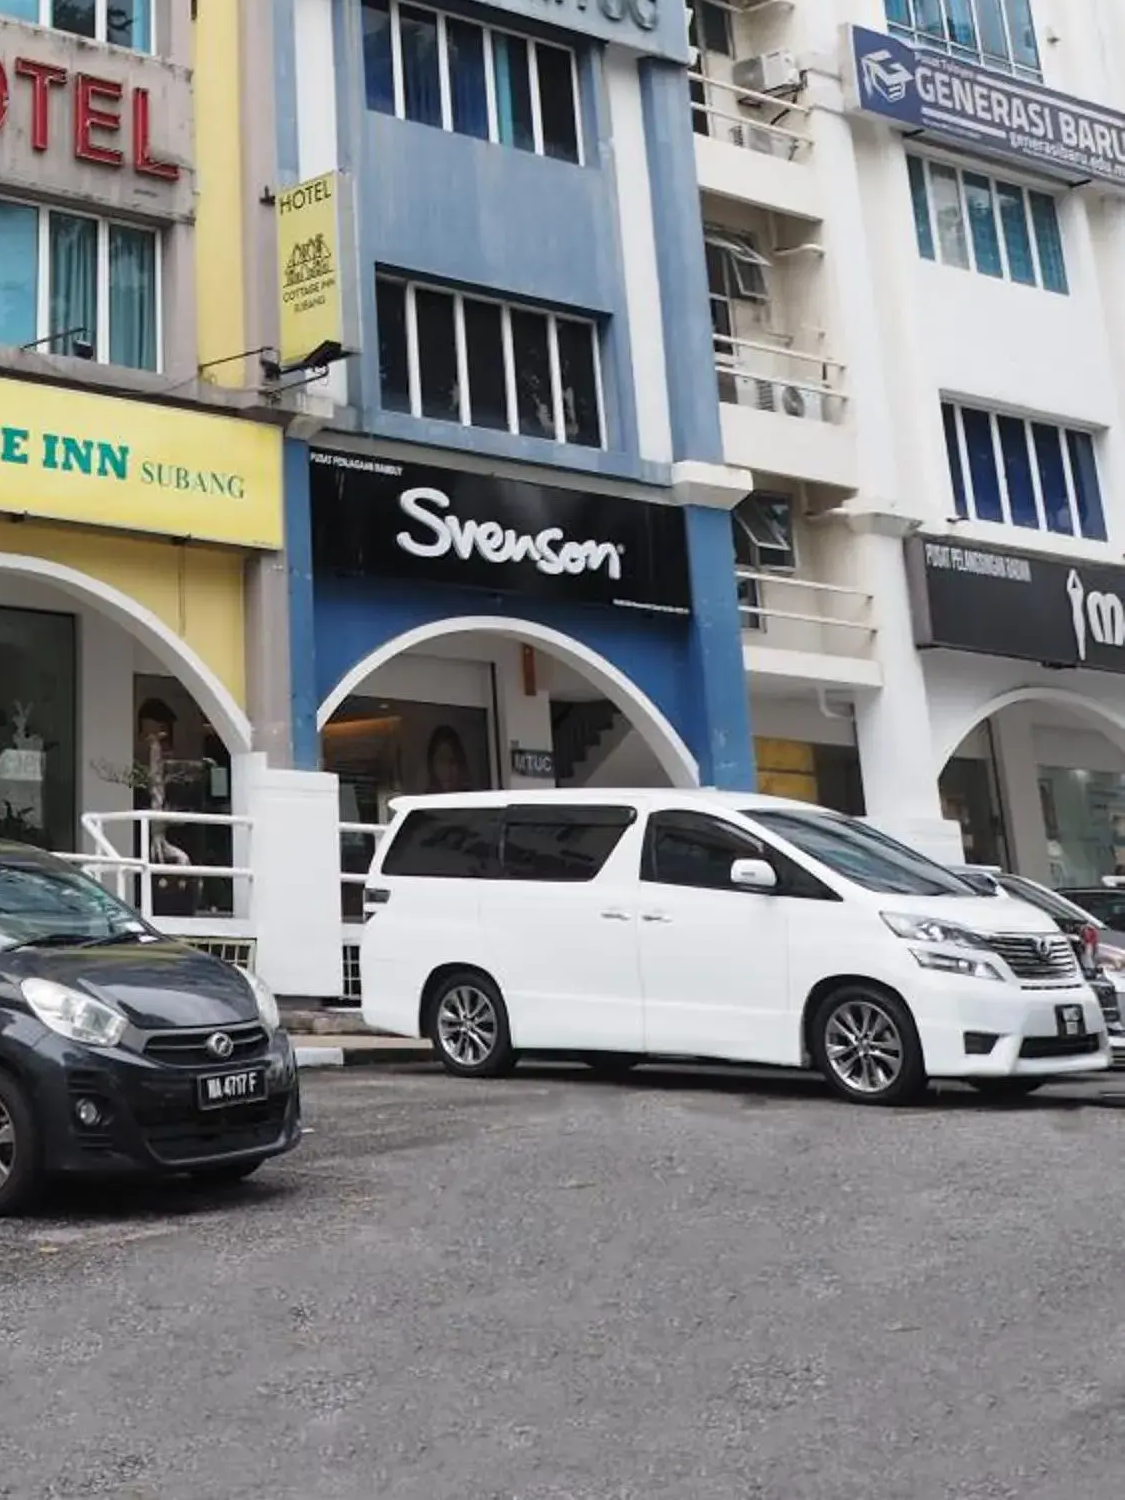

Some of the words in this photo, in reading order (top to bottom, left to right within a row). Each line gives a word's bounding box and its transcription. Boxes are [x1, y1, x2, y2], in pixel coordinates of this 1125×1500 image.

[915, 67, 1054, 140] GENERASI
[279, 180, 332, 215] HOTEL
[42, 433, 130, 480] INN
[141, 460, 247, 499] SUBANG
[396, 487, 622, 581] Svenson
